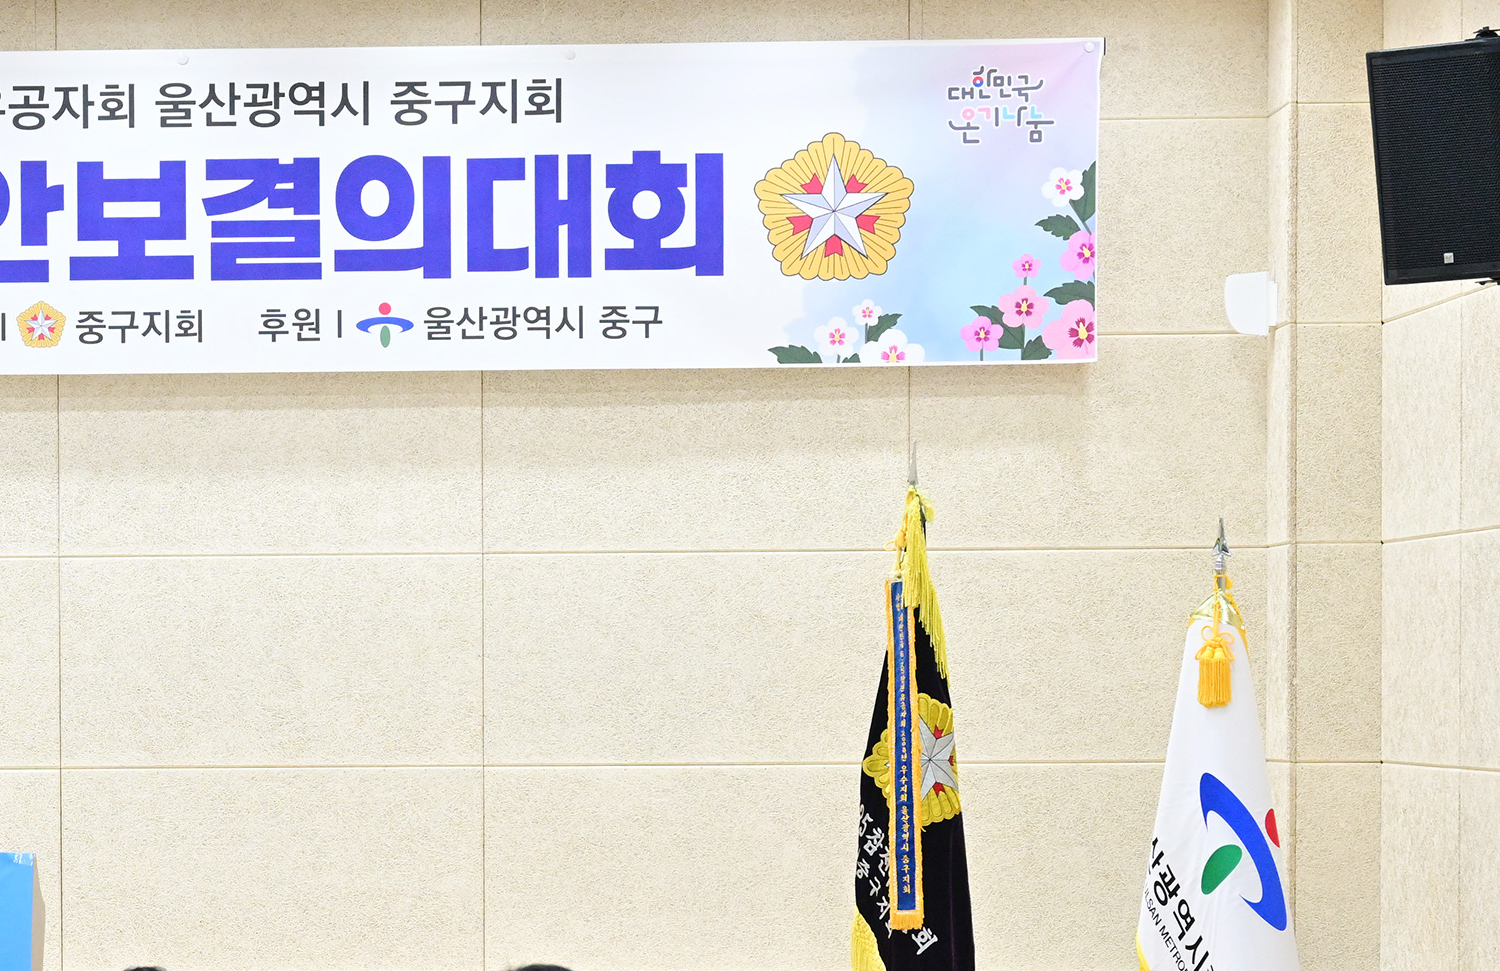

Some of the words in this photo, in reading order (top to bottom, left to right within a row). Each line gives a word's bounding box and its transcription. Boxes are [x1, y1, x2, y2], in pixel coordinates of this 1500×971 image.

[155, 80, 369, 128] 울산광역시
[390, 77, 562, 126] 중구지회
[947, 65, 1044, 103] 대한민국
[948, 105, 1055, 144] 온기나눔
[75, 309, 203, 345] 중구지회
[258, 308, 321, 343] 후원
[423, 305, 584, 341] 울산광역시
[599, 305, 663, 340] 중구
